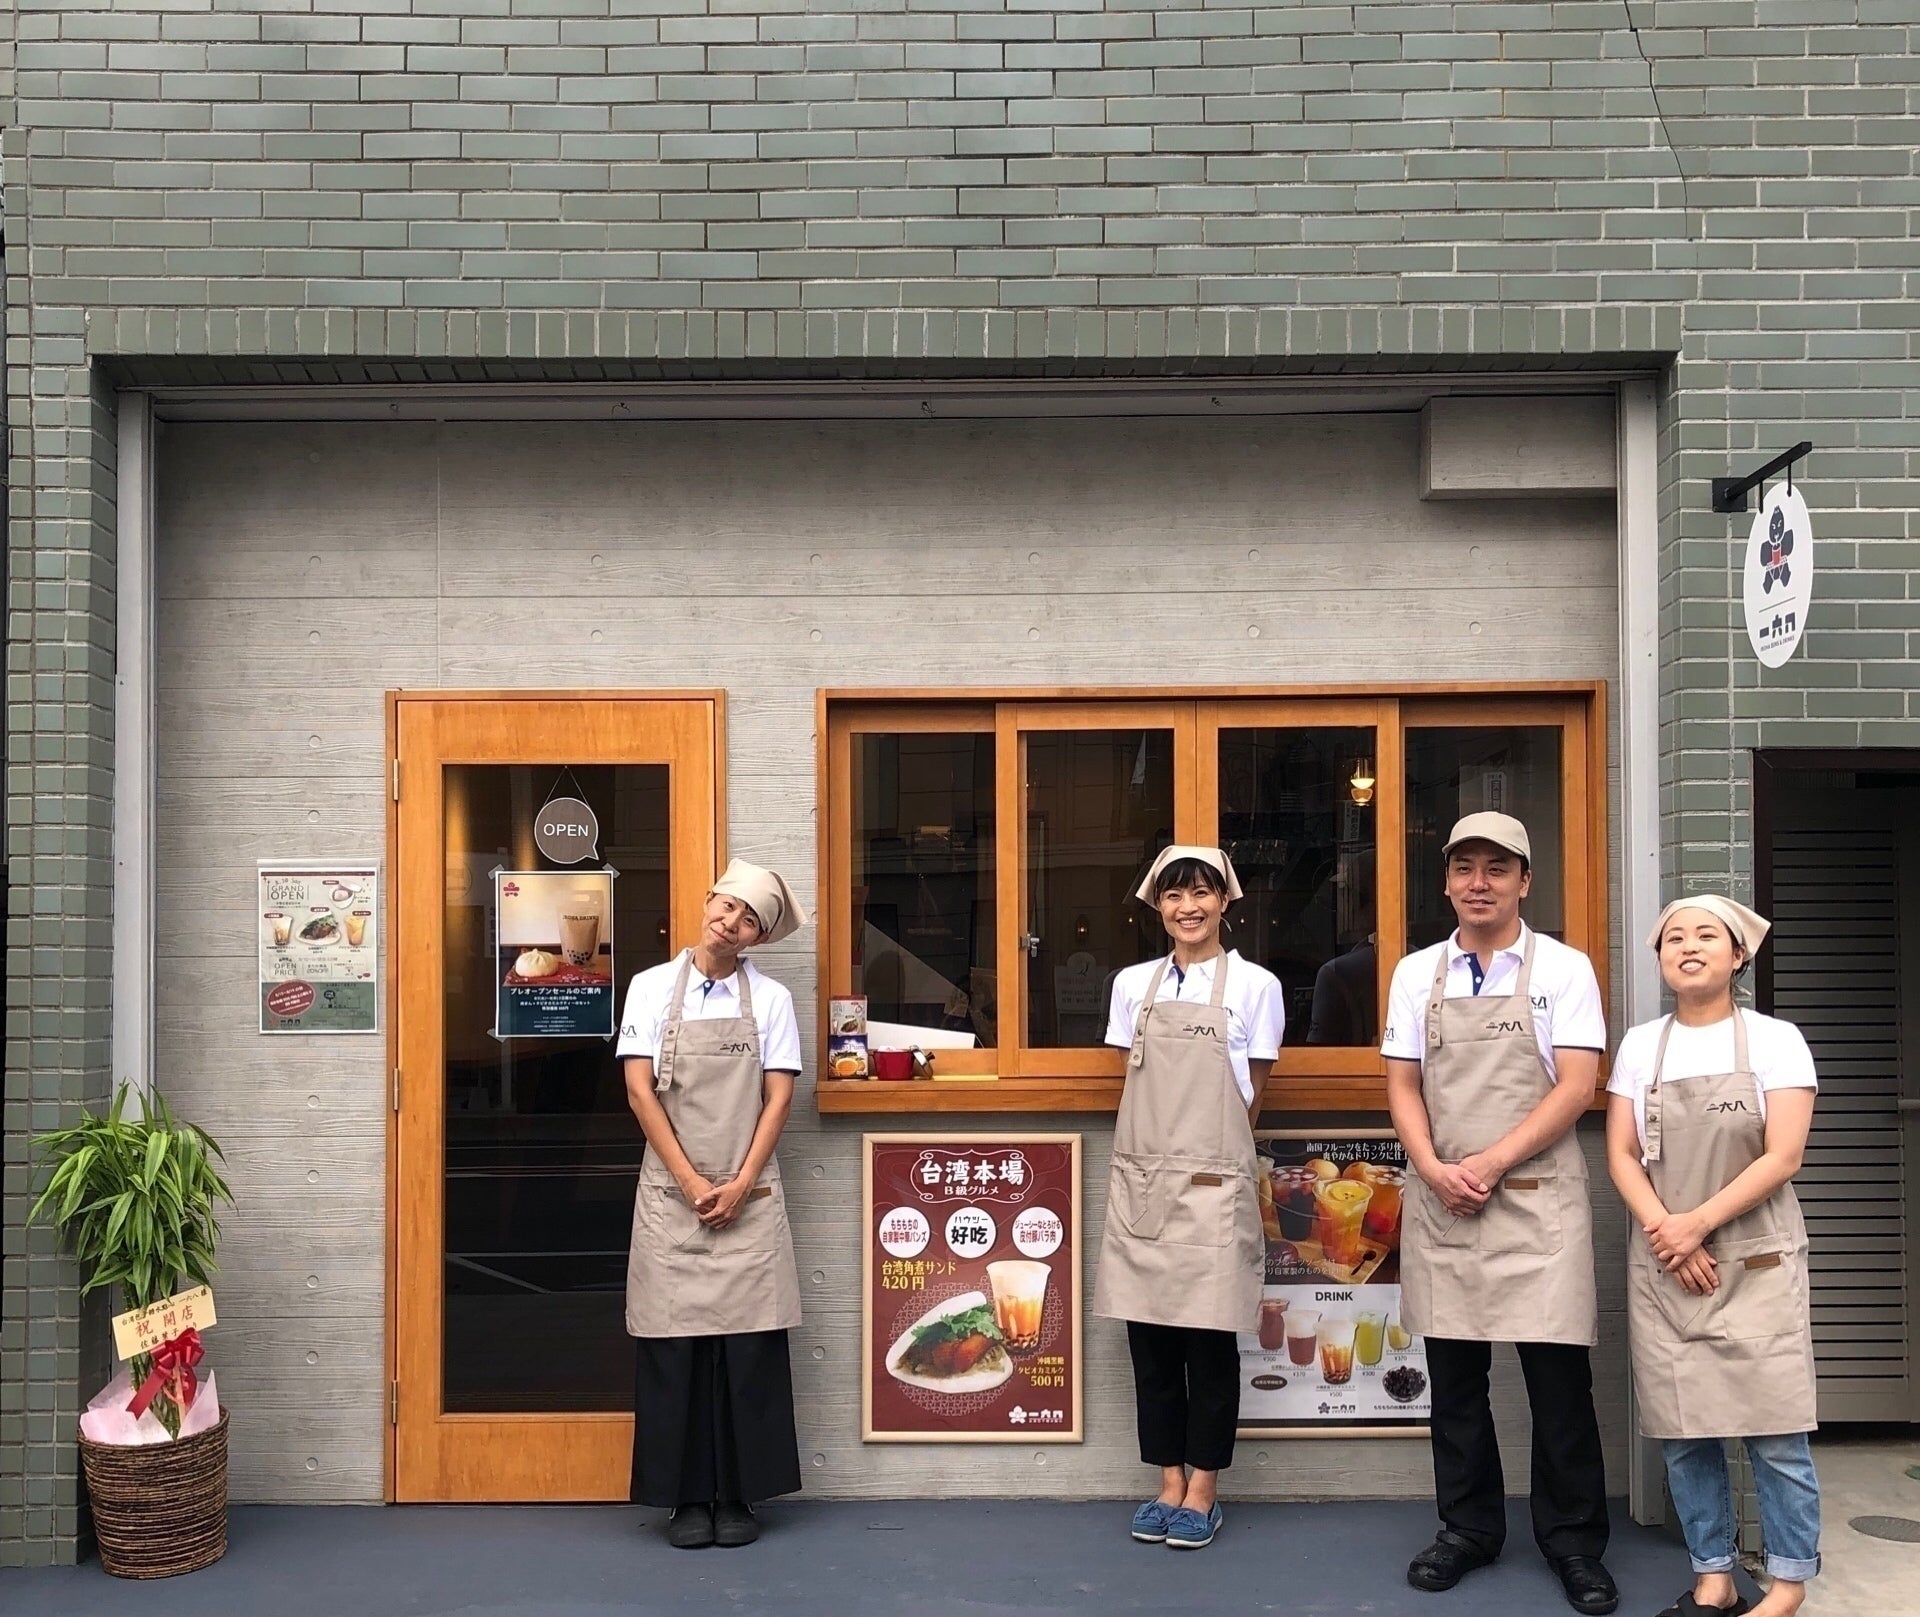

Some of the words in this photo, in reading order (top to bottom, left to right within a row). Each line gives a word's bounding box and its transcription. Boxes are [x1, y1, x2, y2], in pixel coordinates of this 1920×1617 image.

[543, 824, 589, 837] OPEN
[271, 891, 304, 900] OPEN
[510, 987, 602, 995] プレオープンセールのご案内
[1183, 1025, 1216, 1037] 一六八
[1486, 1021, 1524, 1032] 一六八
[720, 1042, 751, 1053] 一六八
[1707, 1100, 1746, 1113] 一六八
[1306, 1142, 1405, 1152] 南国フルーツをたっぷり使
[920, 1160, 1024, 1185] 台湾本場
[945, 1186, 999, 1195] B級グルメ
[891, 1218, 918, 1230] もちもちの
[1015, 1220, 1060, 1230] ジューシーなとろける
[951, 1226, 988, 1245] 好吃
[882, 1260, 956, 1275] 台湾角煮サンド
[882, 1276, 925, 1290] 420円
[1315, 1291, 1353, 1301] DRINK
[1018, 1366, 1064, 1374] タピオカミルク
[1031, 1375, 1064, 1387] 500円
